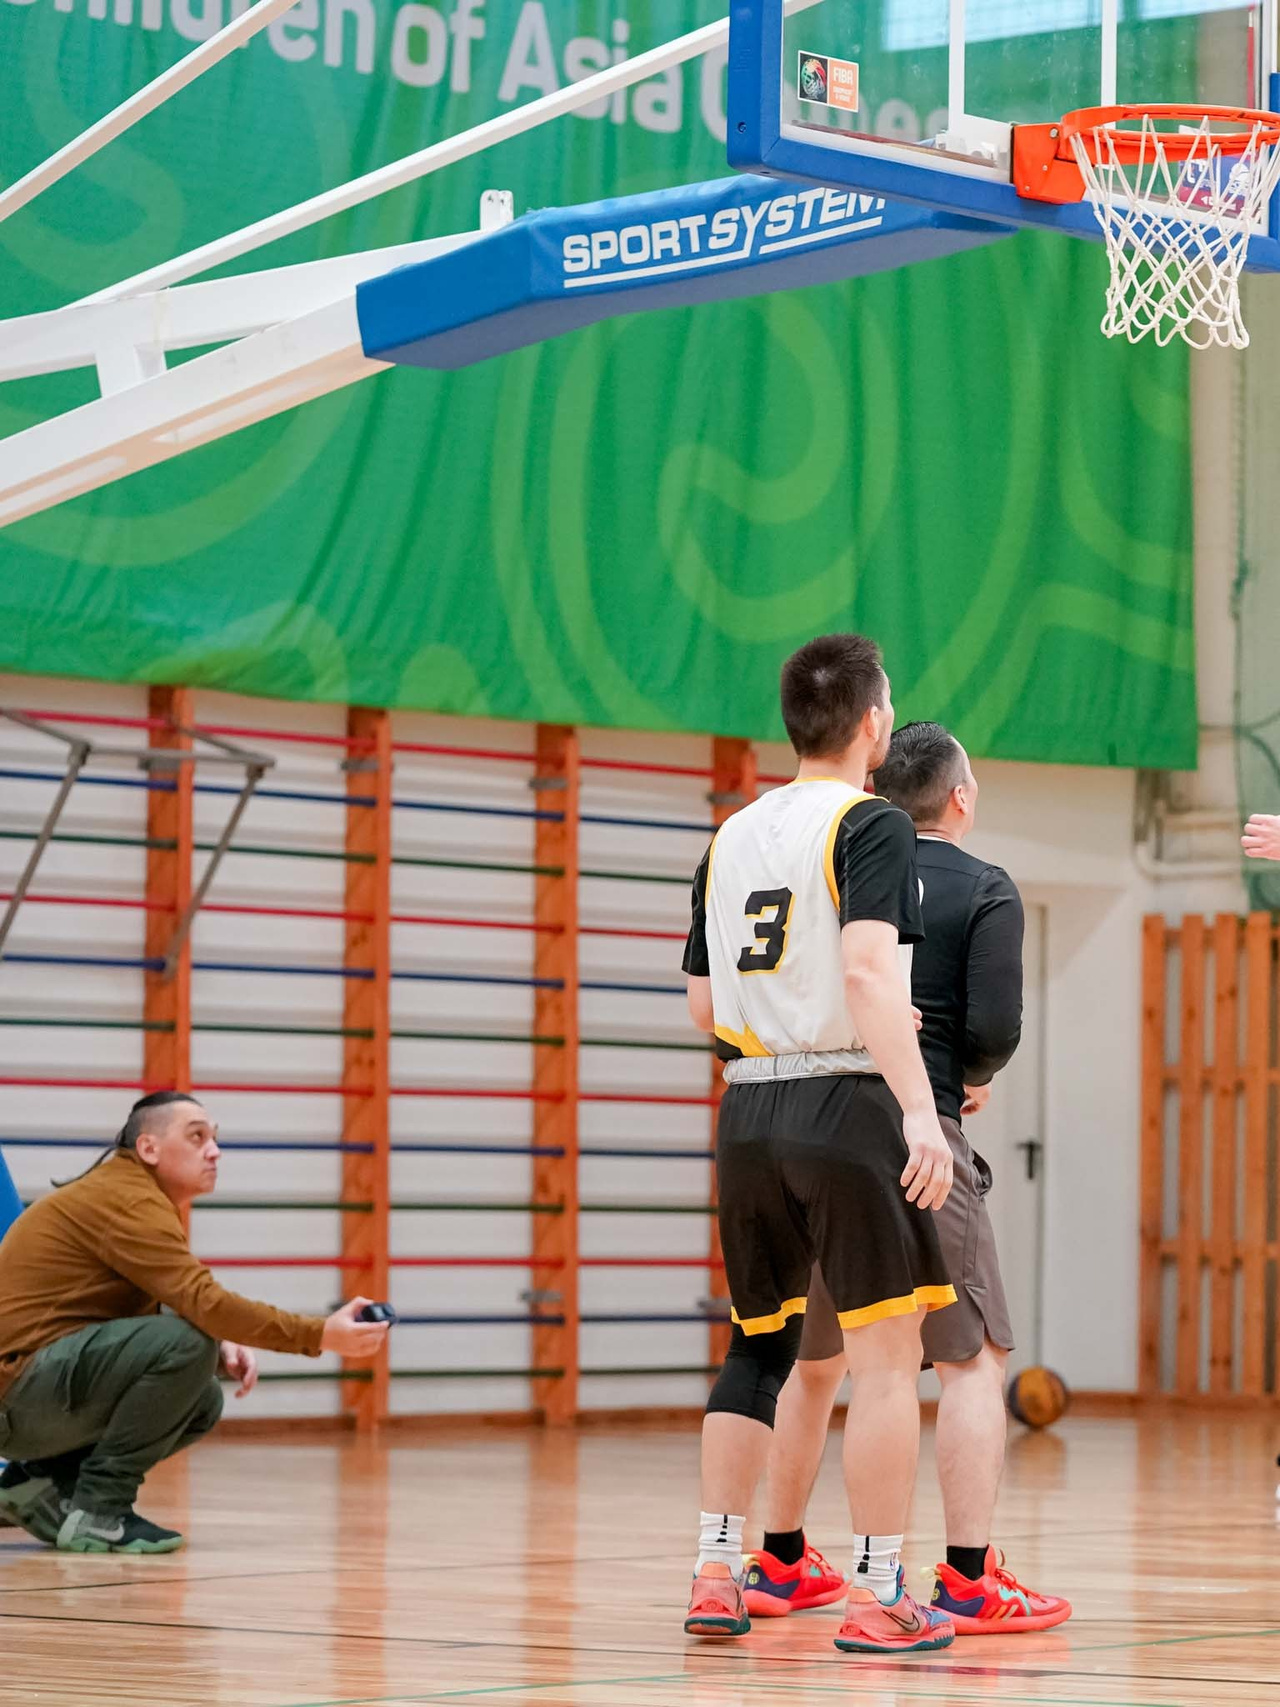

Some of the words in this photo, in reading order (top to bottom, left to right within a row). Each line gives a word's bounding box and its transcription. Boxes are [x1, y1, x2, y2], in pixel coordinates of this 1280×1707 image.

[391, 0, 486, 93] of
[833, 67, 854, 85] FIBA
[736, 886, 796, 974] 3
